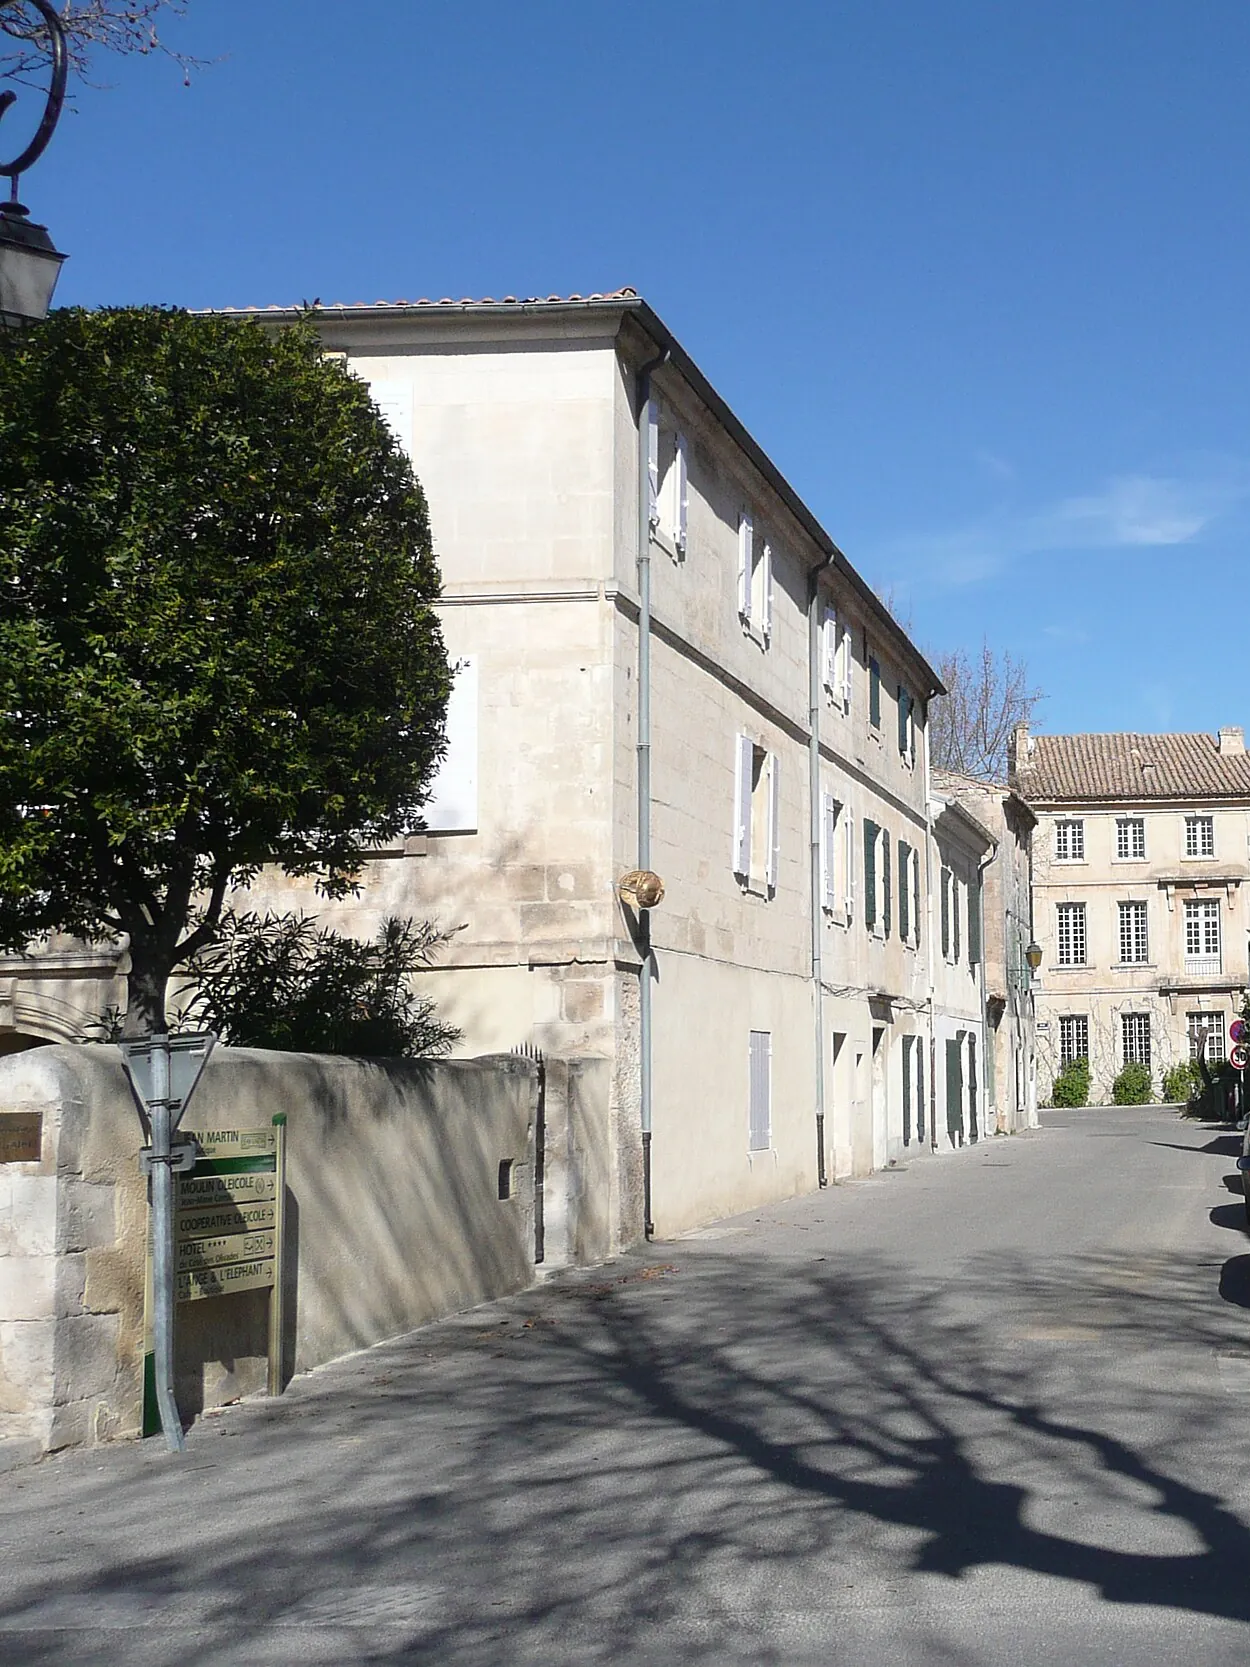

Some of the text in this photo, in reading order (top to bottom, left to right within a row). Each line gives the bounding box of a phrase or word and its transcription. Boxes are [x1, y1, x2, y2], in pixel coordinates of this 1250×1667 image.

[1235, 1052, 1247, 1061] 30
[206, 1130, 239, 1144] MARTIN
[180, 1176, 255, 1195] MOULIN OLEICOLE
[179, 1209, 266, 1232] COOPERATIVE OLEICOLE
[179, 1242, 206, 1257] HOTEL
[178, 1262, 263, 1288] L'ANGE & L'ELEPHANT
